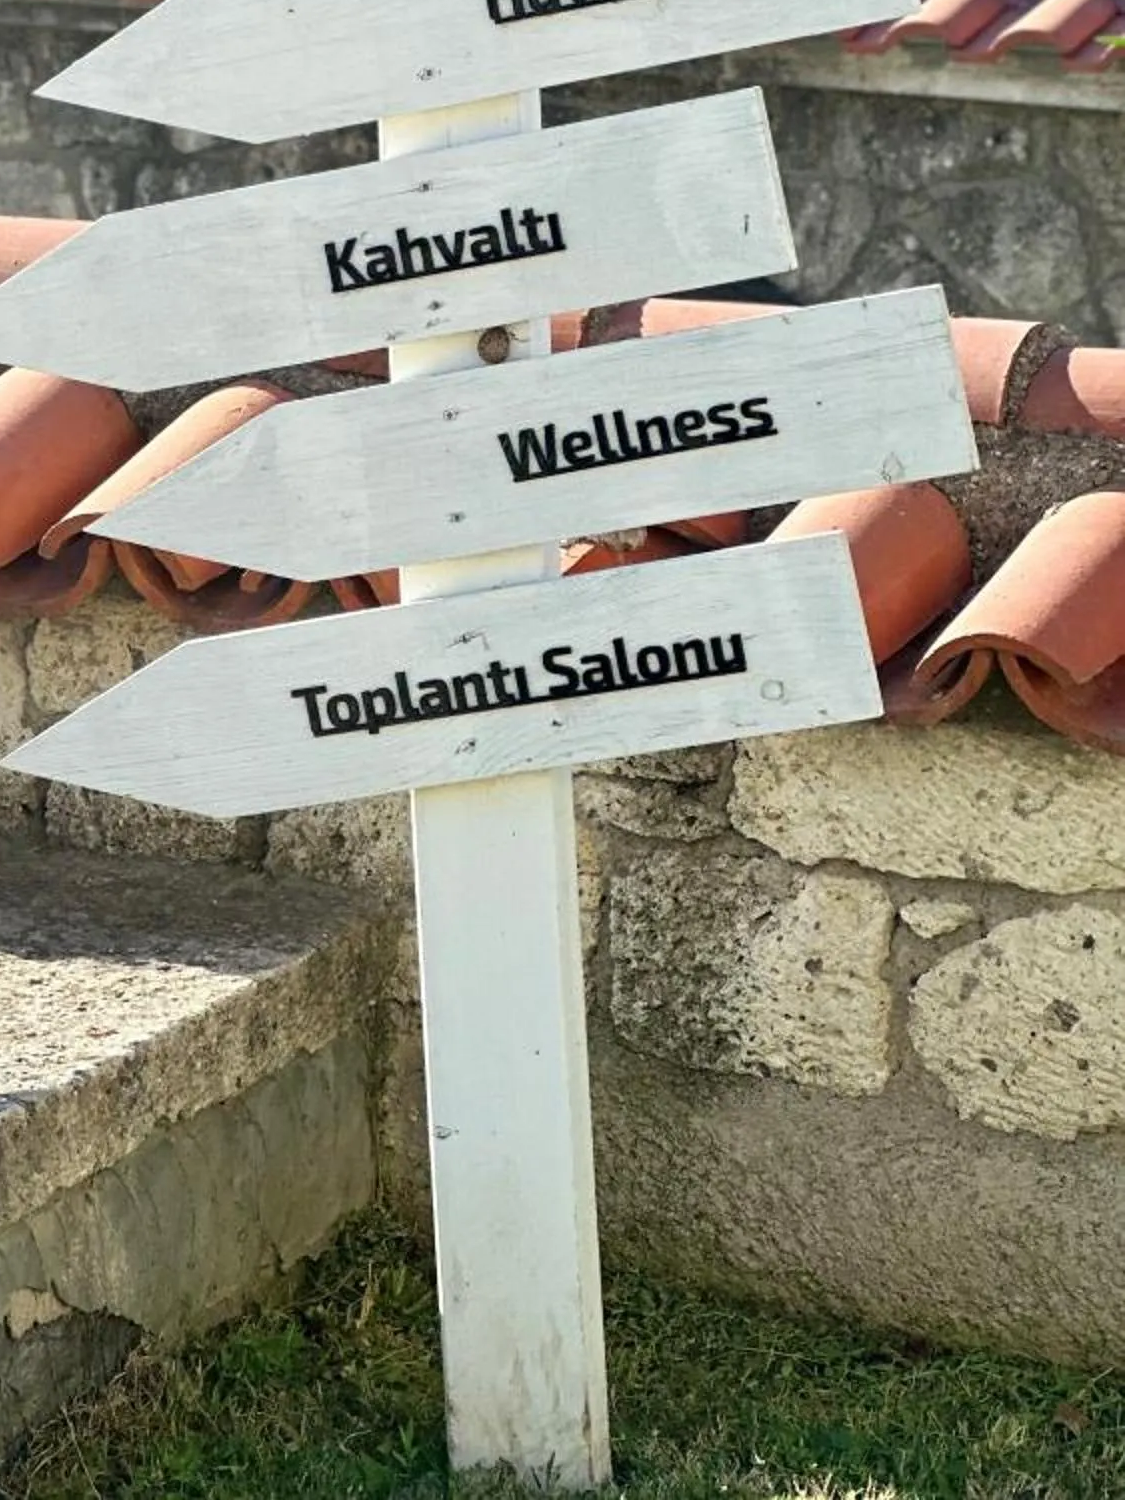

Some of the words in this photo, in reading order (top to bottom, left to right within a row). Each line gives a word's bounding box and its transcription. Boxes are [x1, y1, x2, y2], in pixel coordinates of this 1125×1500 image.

[324, 207, 567, 294] Kahvaltı
[497, 397, 779, 483] Wellness
[291, 660, 530, 738] Toplantı
[541, 633, 748, 695] Salonu
